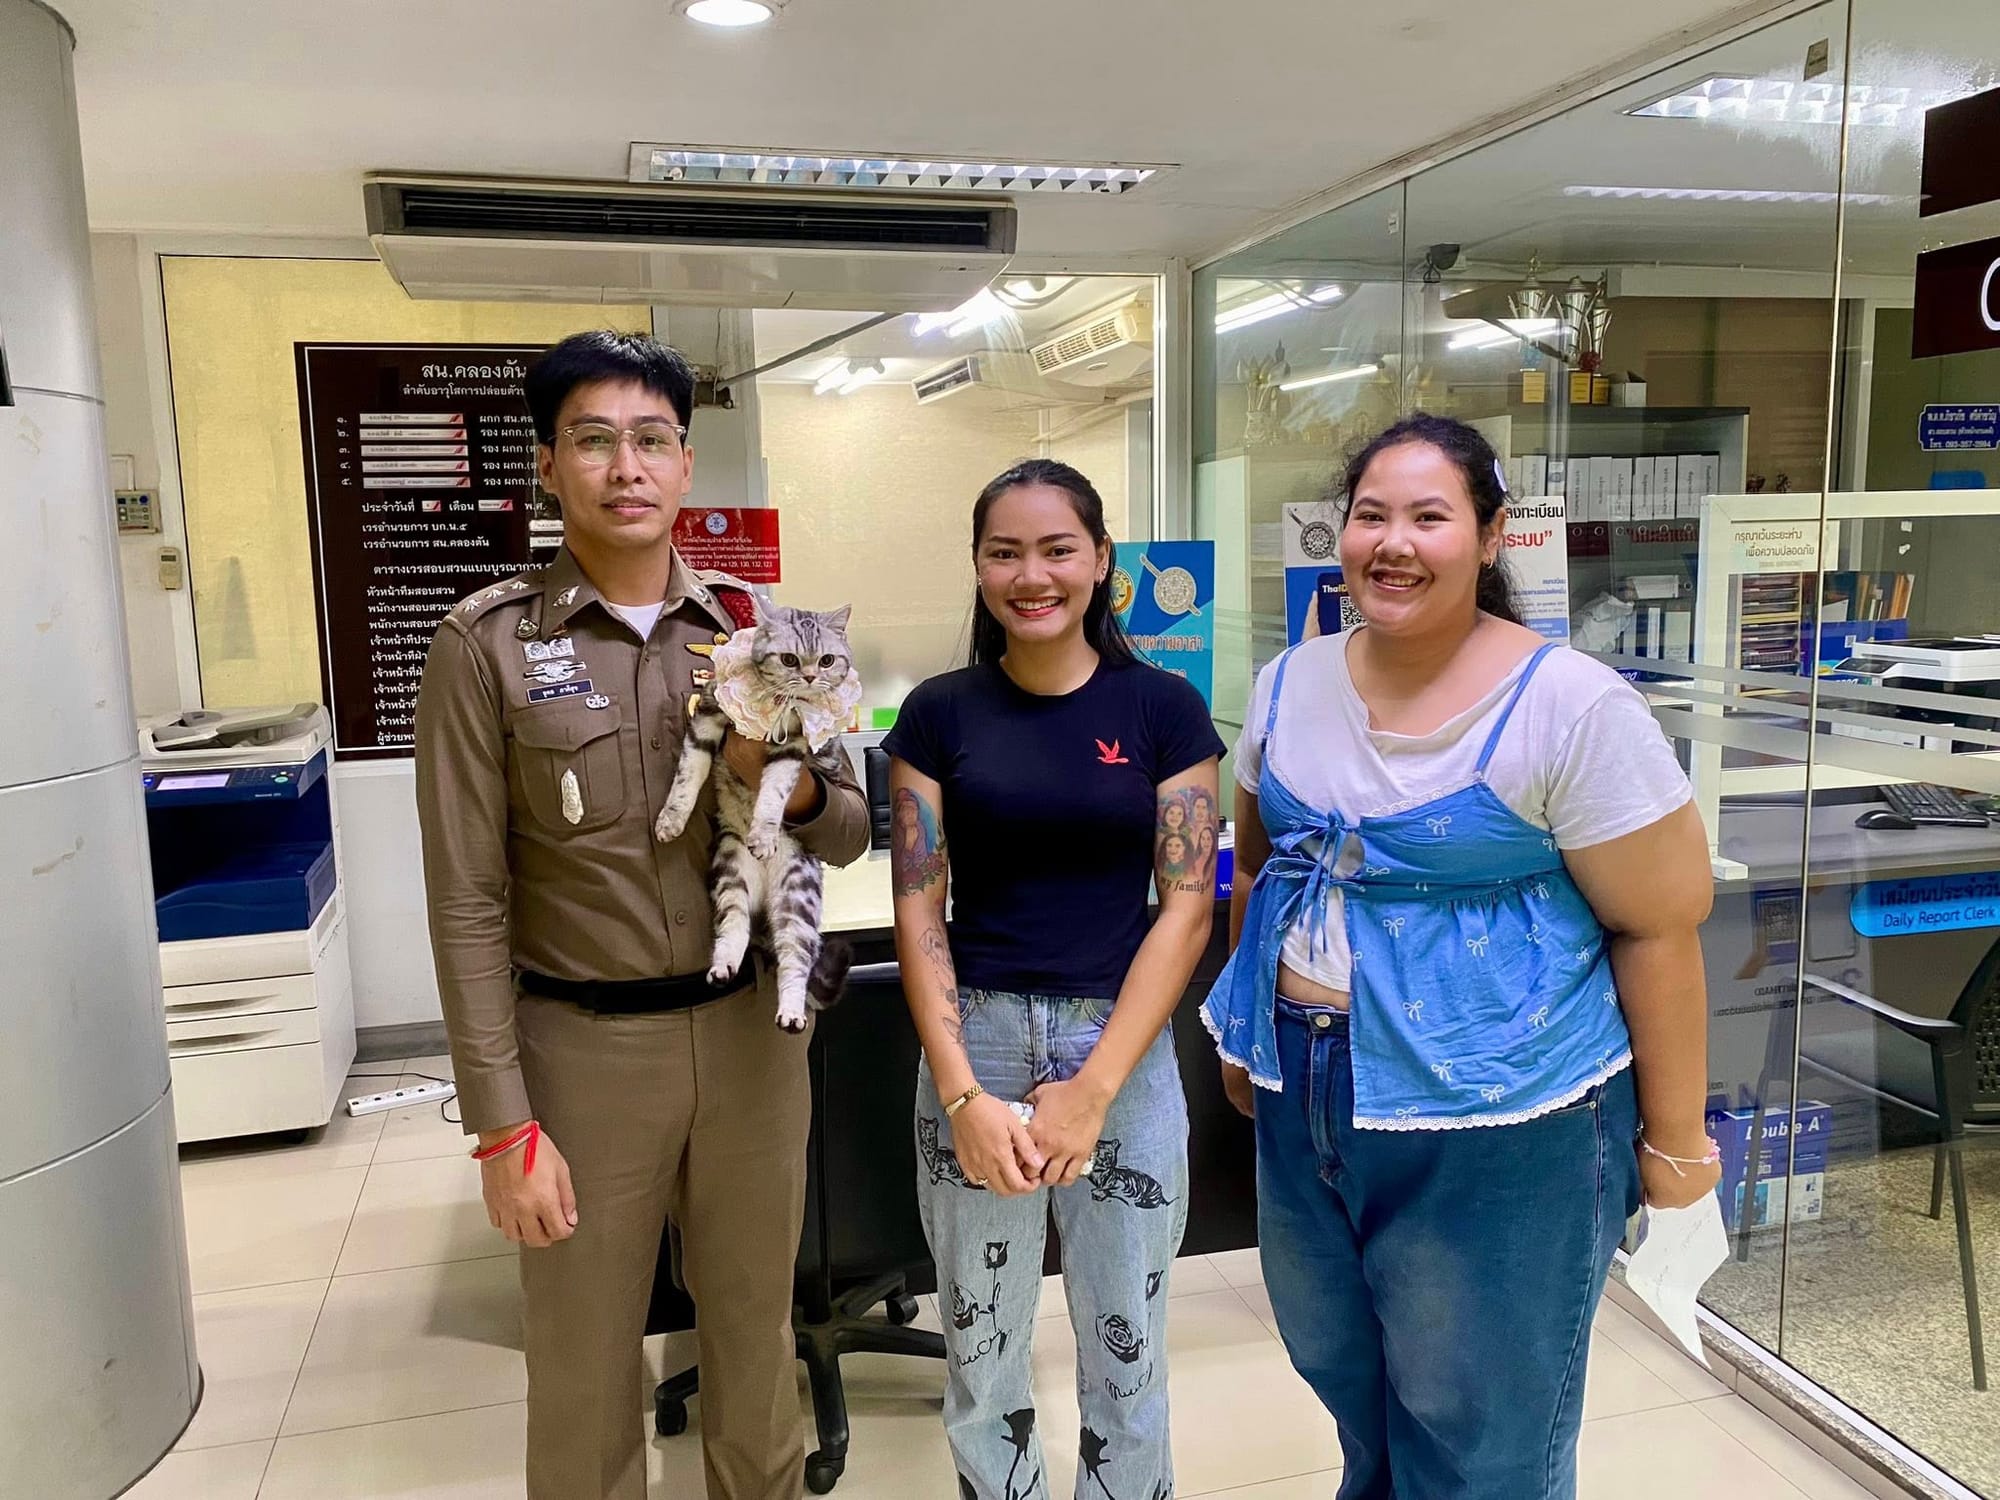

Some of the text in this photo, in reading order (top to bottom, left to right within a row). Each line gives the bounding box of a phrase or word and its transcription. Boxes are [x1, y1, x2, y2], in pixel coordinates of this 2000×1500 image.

[480, 428, 499, 437] รอง
[481, 444, 499, 453] รอง
[482, 461, 501, 470] รอง
[483, 477, 502, 486] รอง
[448, 499, 475, 512] เดือน
[361, 521, 429, 532] เวรอำนวยการ
[363, 536, 490, 549] เวรอำนวยการ สน.คลองตัน
[366, 585, 456, 597] หัวหน้าทีมสอบสวน
[1883, 905, 1996, 929] Daily Report Clerk
